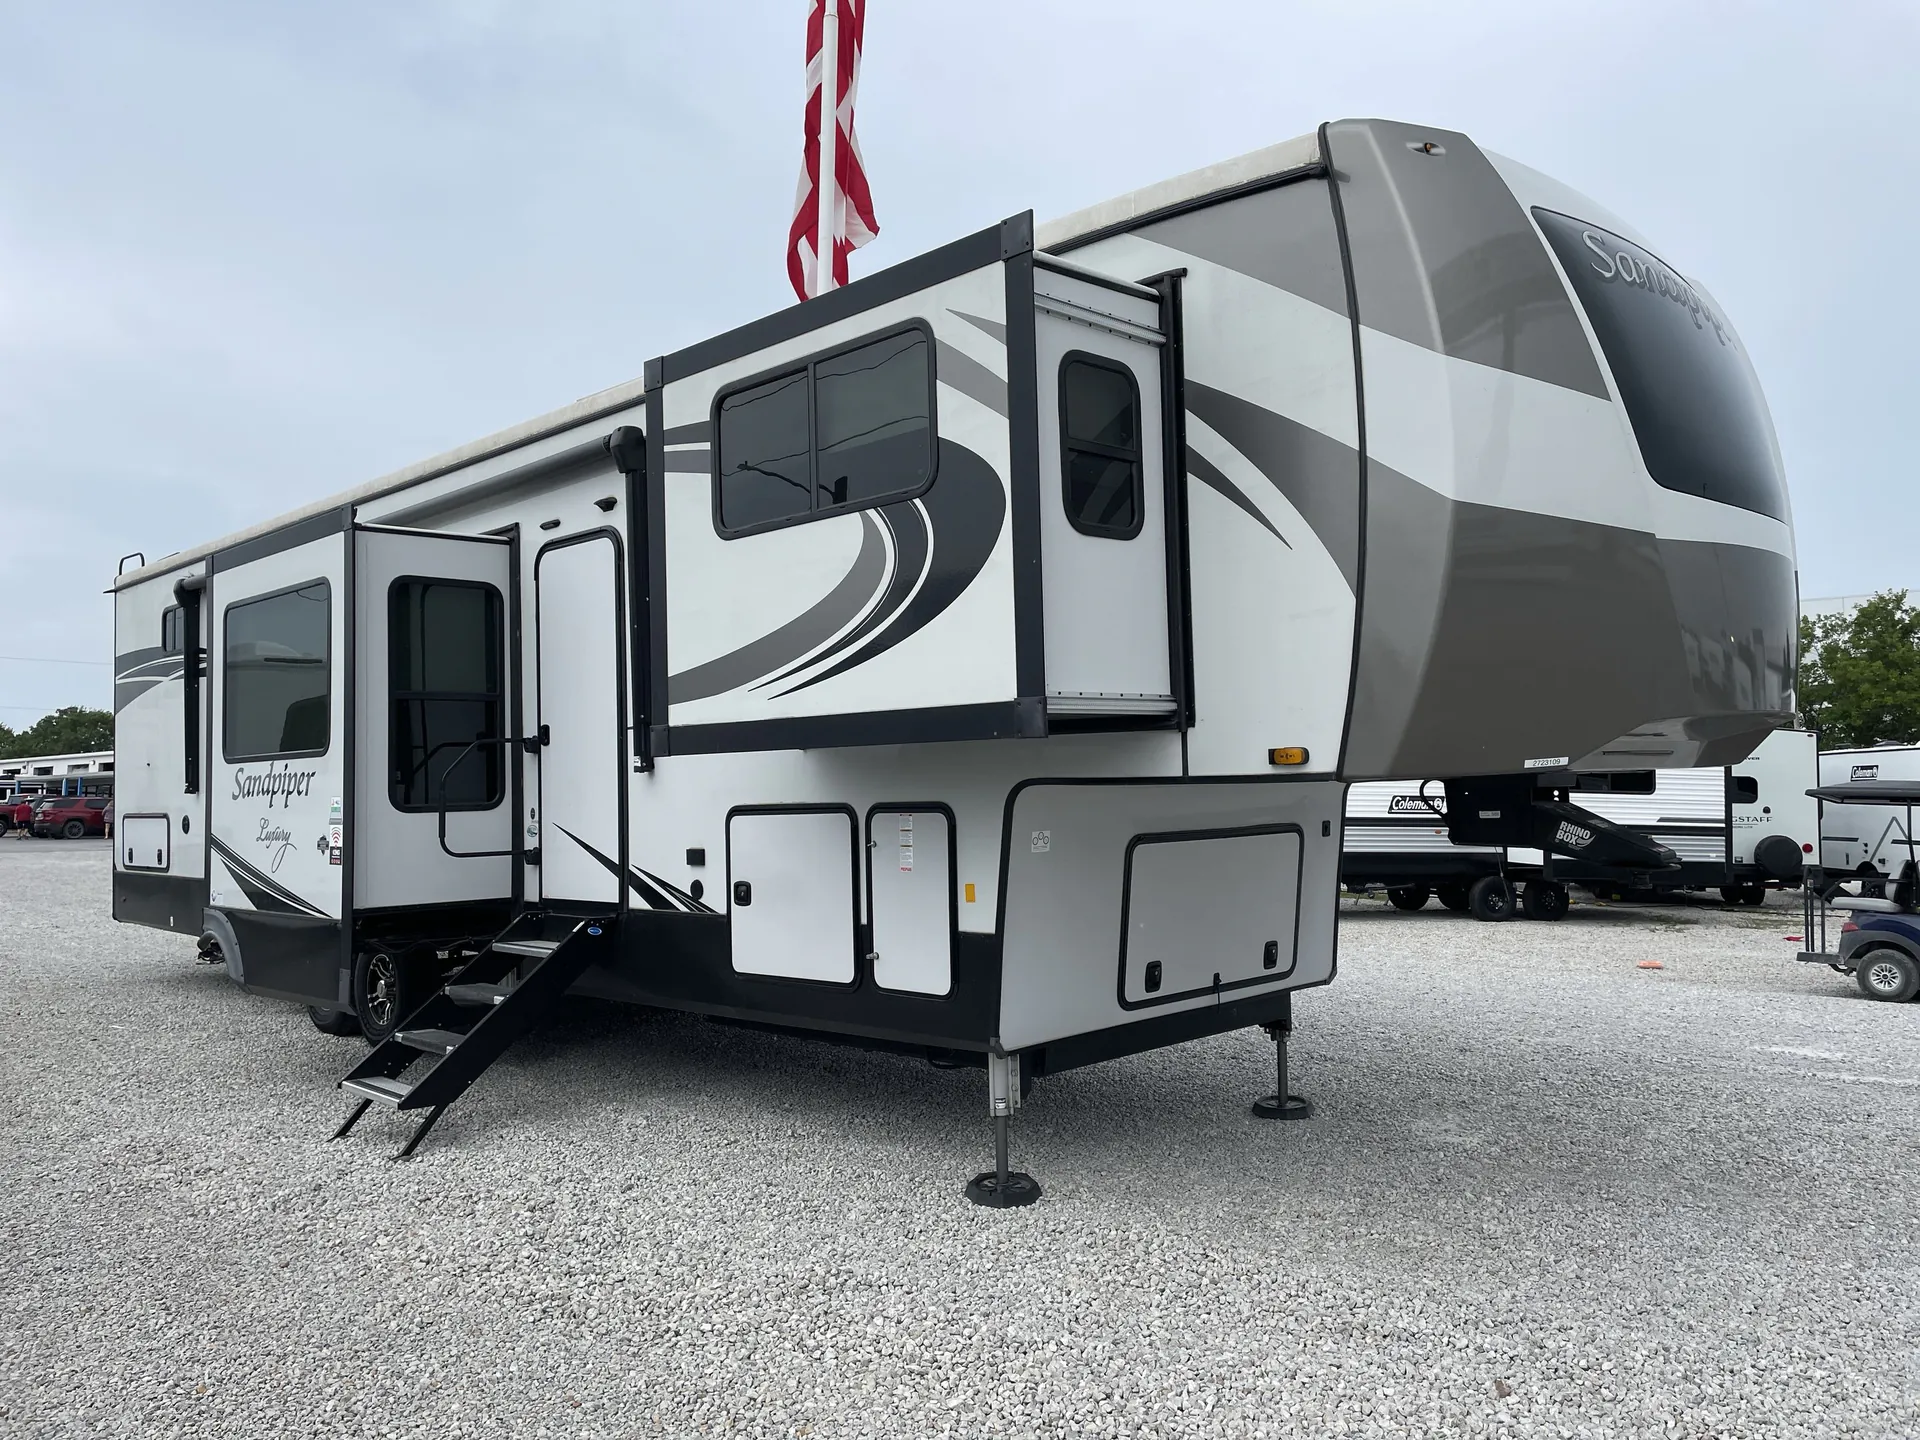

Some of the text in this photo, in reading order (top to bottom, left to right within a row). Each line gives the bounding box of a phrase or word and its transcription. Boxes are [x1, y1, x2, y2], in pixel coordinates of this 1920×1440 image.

[1582, 230, 1737, 351] Sandpip
[1533, 758, 1561, 767] 2723109
[1853, 767, 1873, 778] Coleman
[232, 760, 316, 808] Sandpiper
[1556, 829, 1579, 845] BOX
[1560, 821, 1591, 840] RHINO
[256, 817, 297, 873] Luxury
